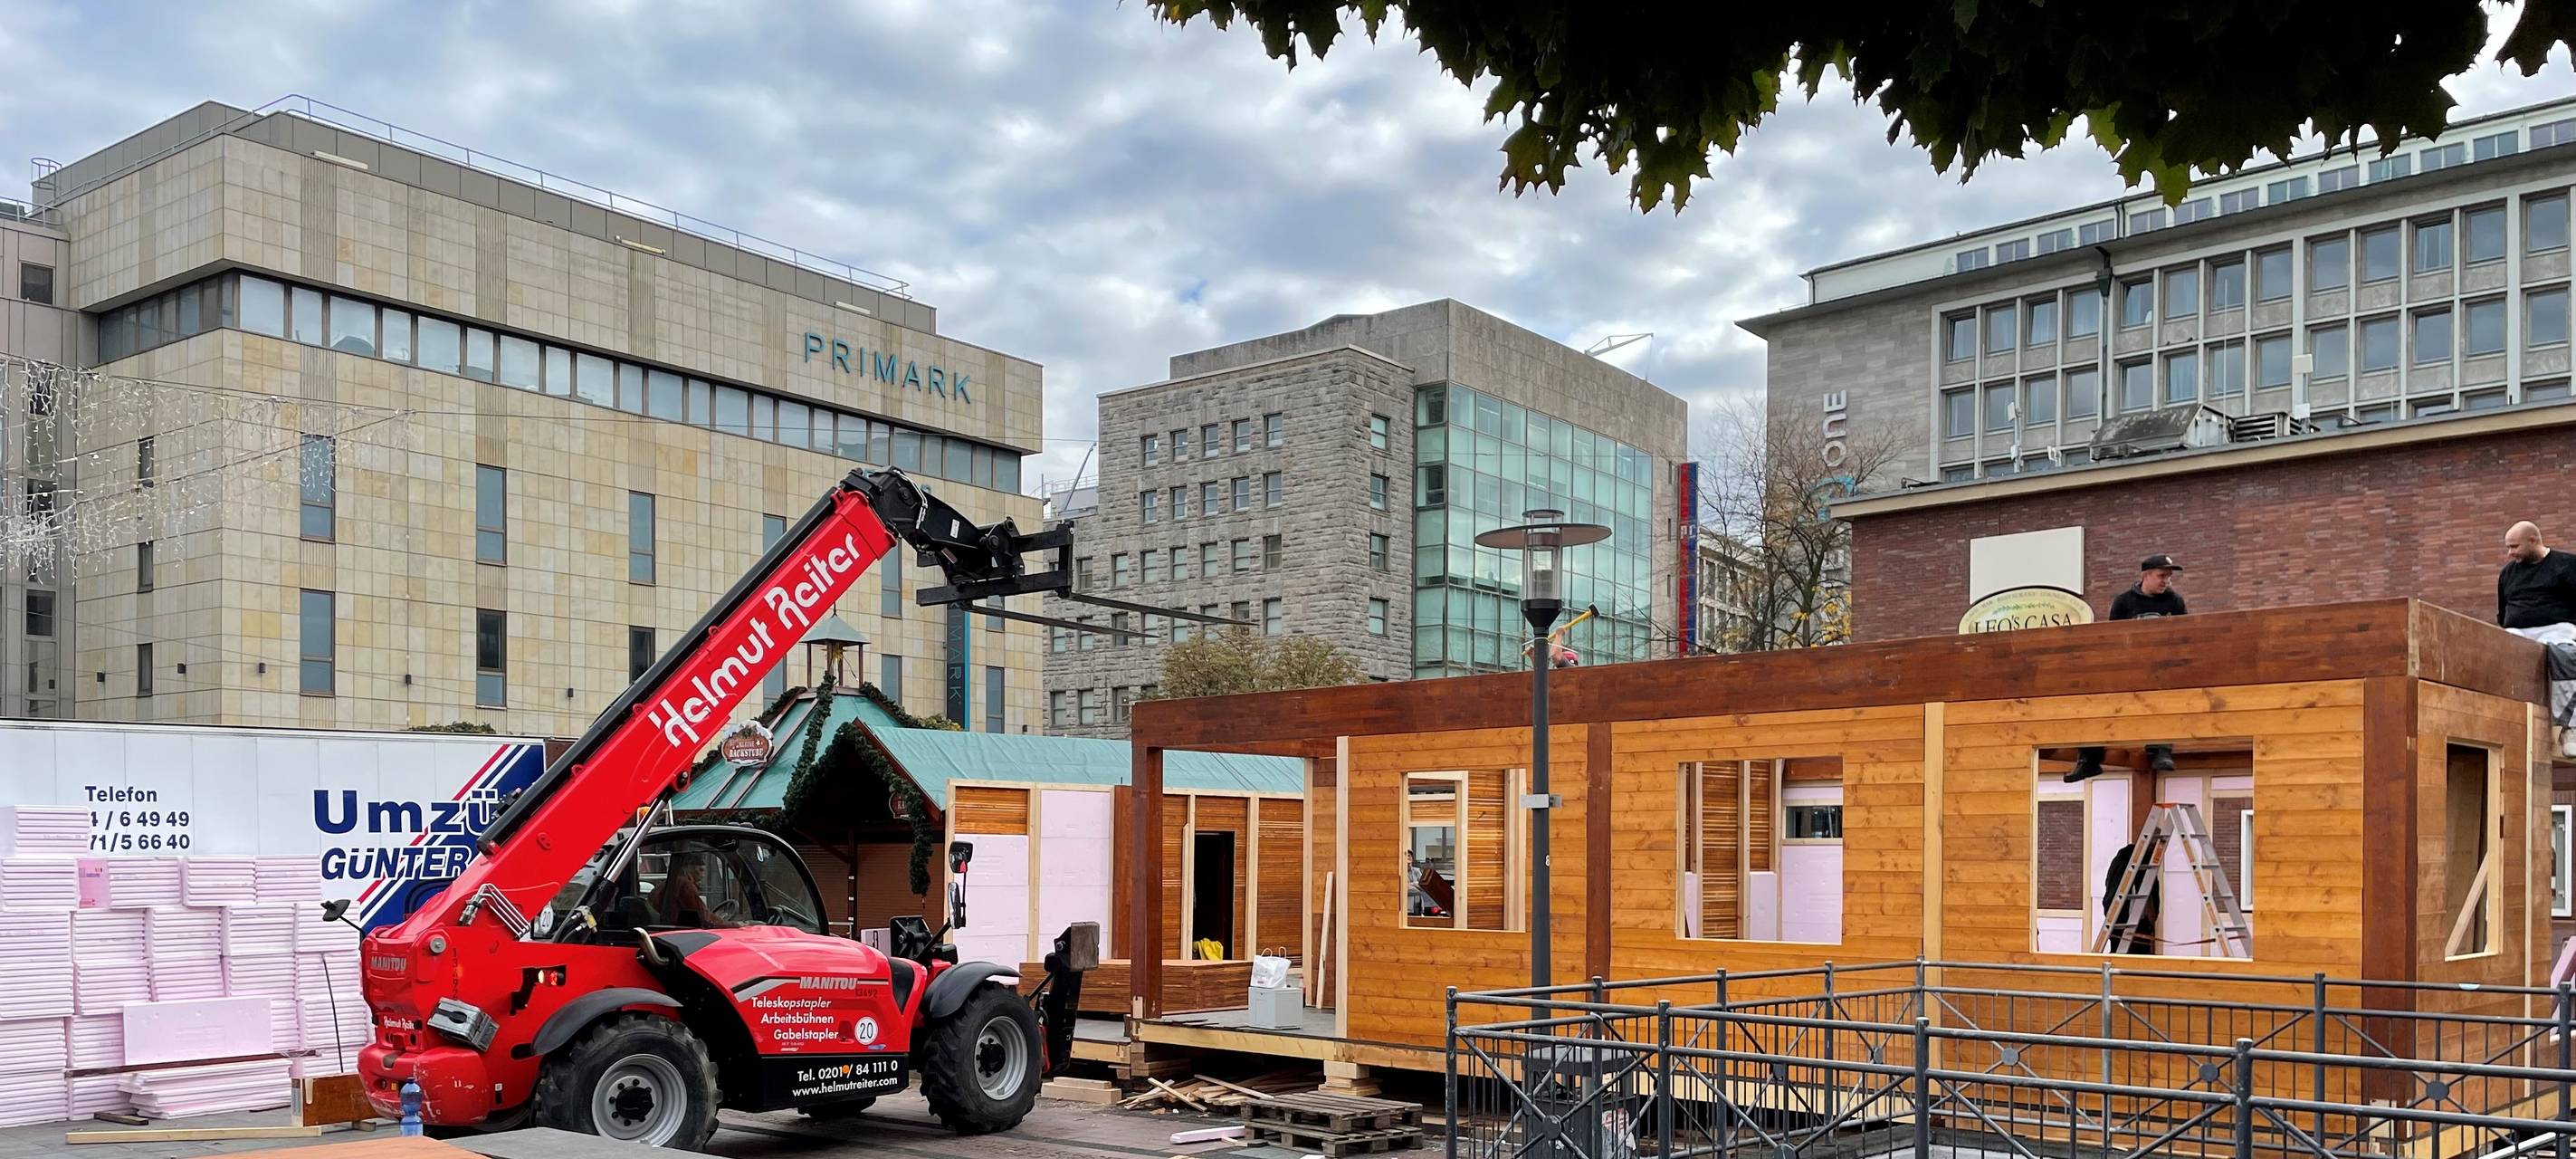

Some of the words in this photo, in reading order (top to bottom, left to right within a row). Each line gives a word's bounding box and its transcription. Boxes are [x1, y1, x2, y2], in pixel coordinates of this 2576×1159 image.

[805, 331, 971, 405] PRIMARK
[648, 617, 775, 748] Helmut
[764, 532, 860, 630] Reiter
[85, 786, 157, 802] Telefon
[119, 811, 131, 827] 6
[137, 811, 160, 827] 49
[167, 811, 189, 827] 49
[138, 835, 162, 849] 66
[167, 834, 190, 849] 40
[371, 956, 406, 972] MANITOU
[799, 976, 858, 990] MANITOU
[751, 996, 831, 1010] Teleskopstapler
[760, 1013, 834, 1024] Arbeitsbühnen
[774, 1029, 839, 1041] Gabelstapler
[859, 1022, 873, 1039] 20
[797, 1070, 816, 1082] Tel.
[818, 1067, 843, 1079] 0201
[855, 1063, 869, 1076] 84
[873, 1061, 887, 1074] 111
[891, 1060, 898, 1072] 0
[792, 1077, 898, 1097] www.helmutreiter.com
